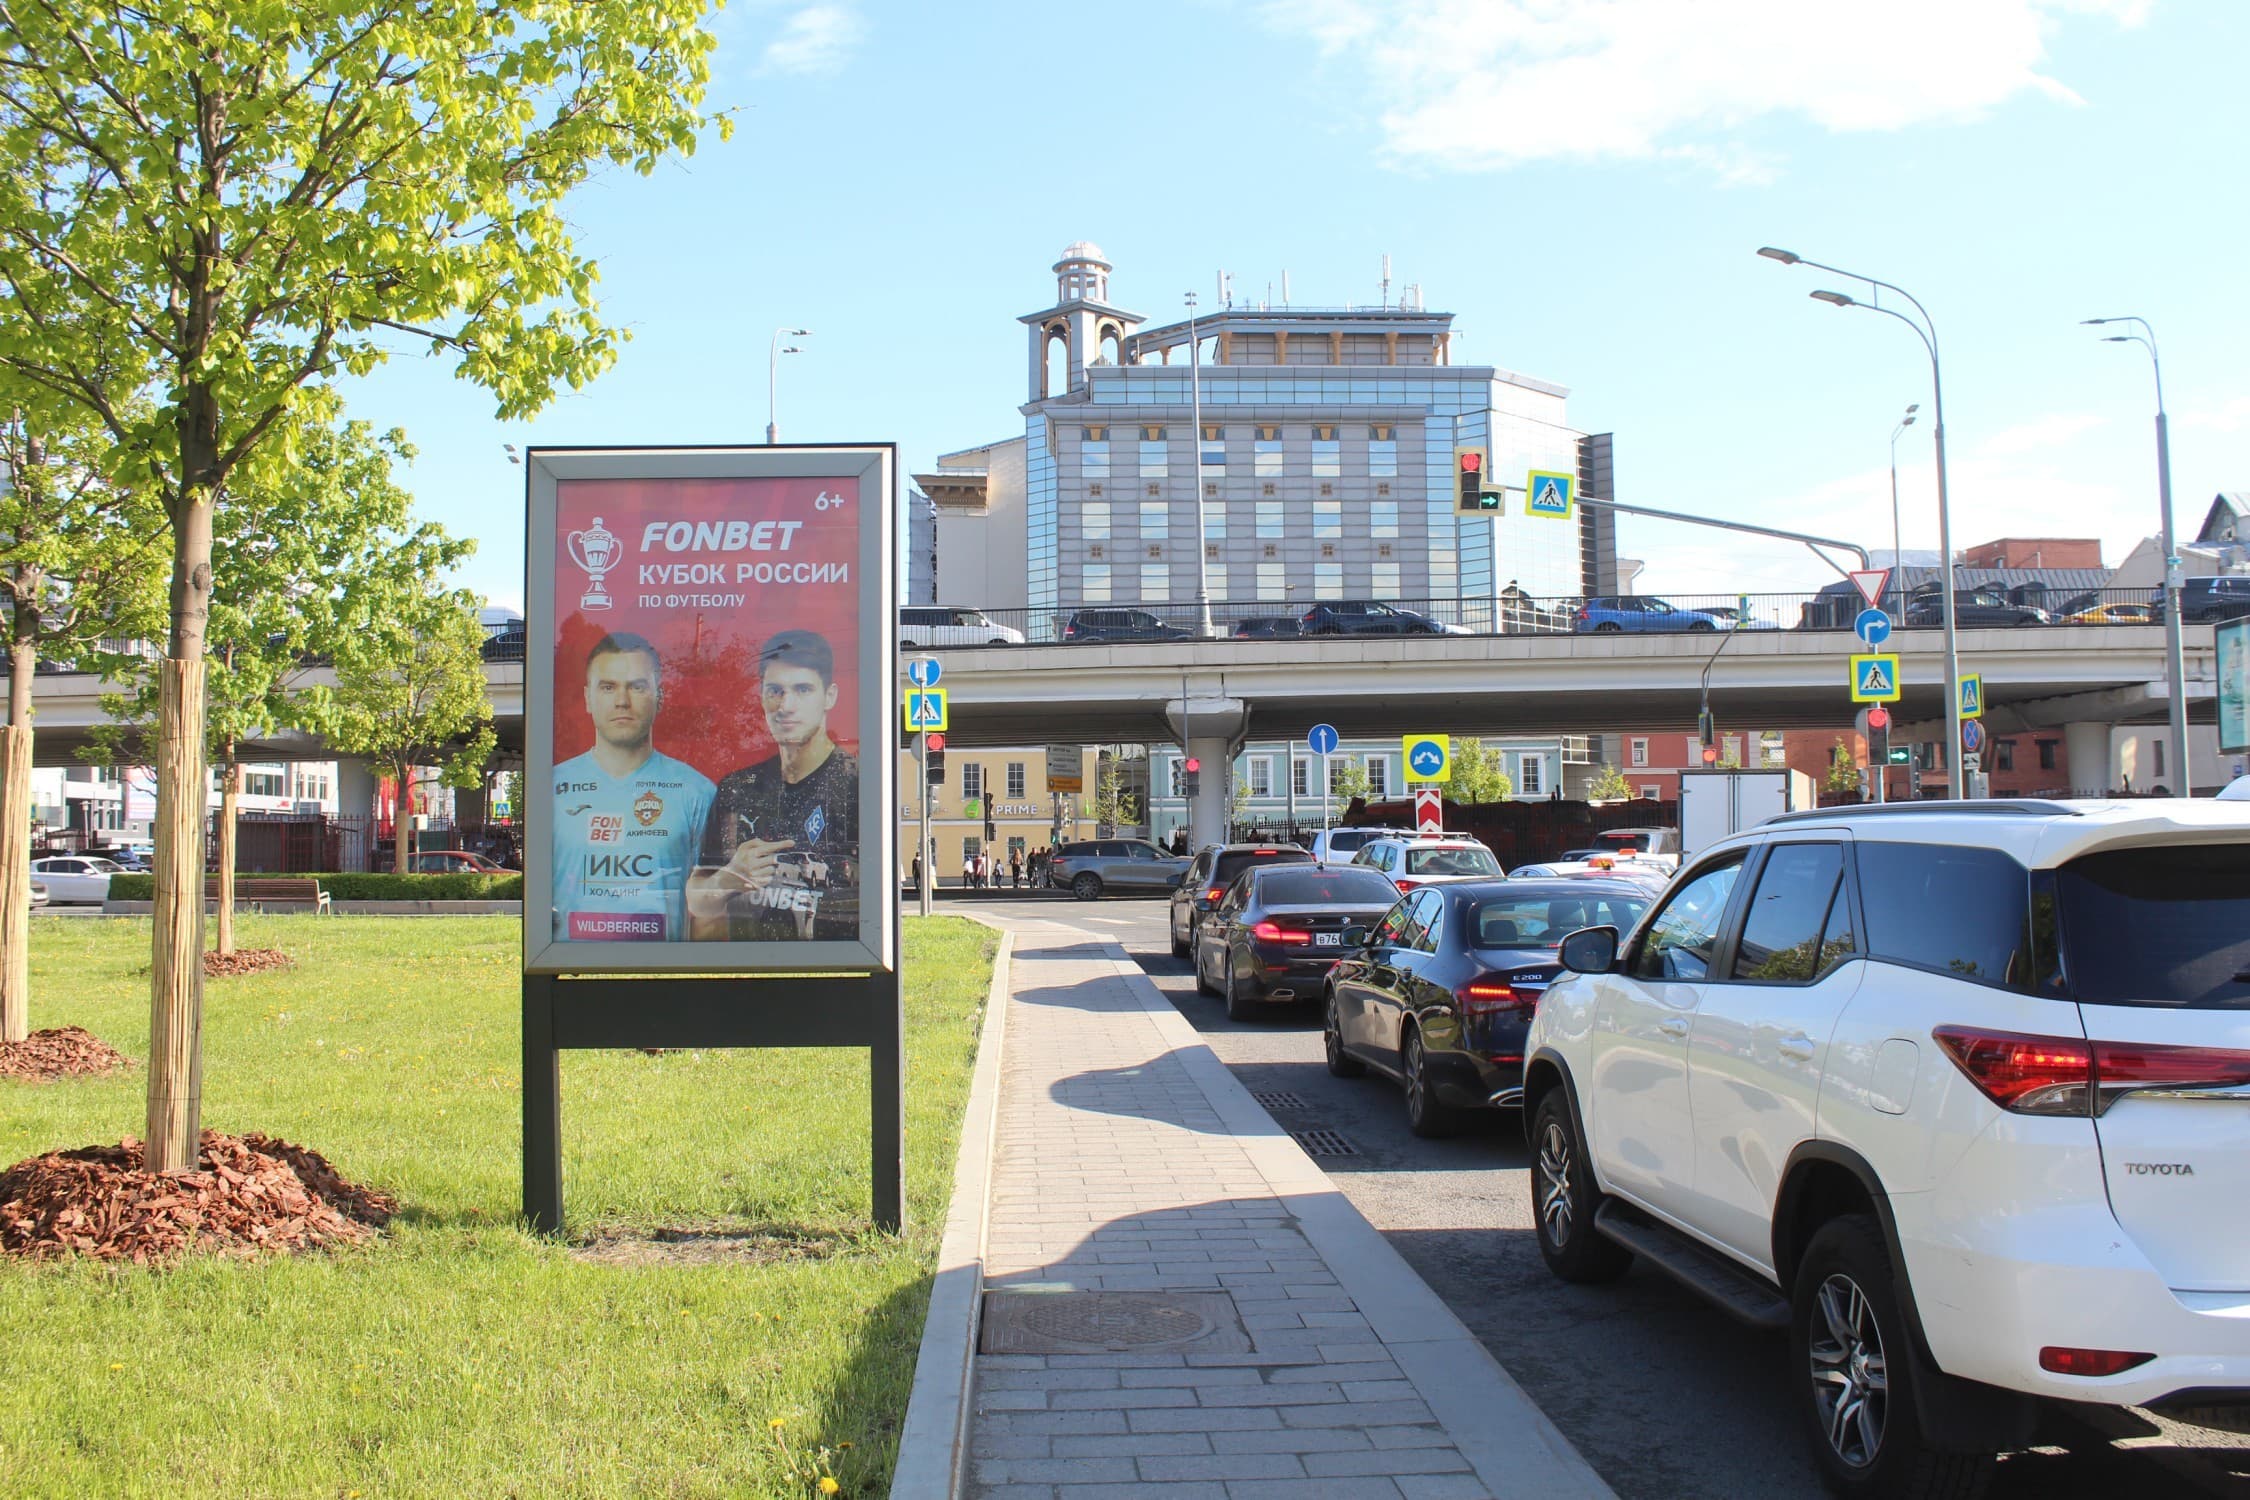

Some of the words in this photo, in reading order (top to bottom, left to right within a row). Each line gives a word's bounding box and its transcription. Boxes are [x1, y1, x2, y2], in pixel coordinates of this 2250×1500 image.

[814, 491, 845, 511] 6+
[640, 521, 802, 552] FONBET
[639, 564, 726, 585] КУБОК
[736, 563, 848, 584] РОССИИ
[639, 595, 661, 608] ПО
[665, 594, 745, 608] ФУТБОЛУ
[572, 782, 598, 792] ПСБ
[657, 781, 683, 789] РОССИИ
[996, 804, 1038, 815] PRIME
[590, 815, 623, 828] FON
[590, 829, 622, 841] BET
[626, 829, 669, 837] АКИНФЕЕВ
[590, 854, 653, 877] ИКС
[589, 887, 641, 898] ХОЛДИНГ
[750, 887, 824, 911] ONBET
[576, 919, 659, 934] WILDBERRIES
[2125, 1163, 2194, 1176] TOYOTA
